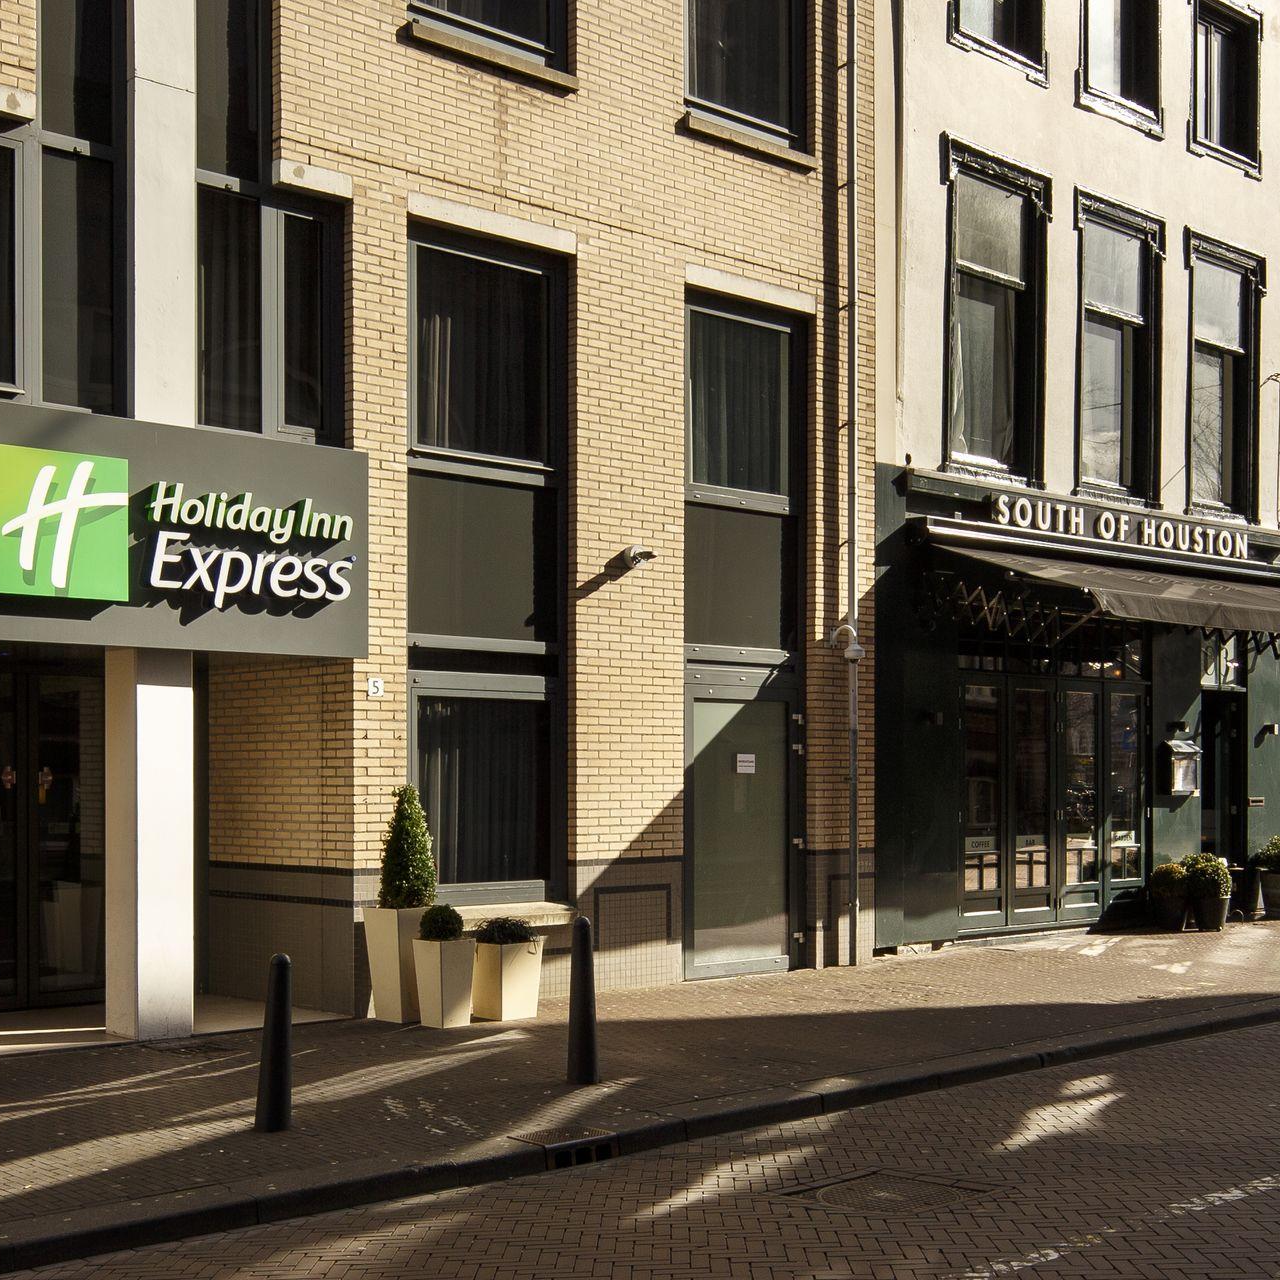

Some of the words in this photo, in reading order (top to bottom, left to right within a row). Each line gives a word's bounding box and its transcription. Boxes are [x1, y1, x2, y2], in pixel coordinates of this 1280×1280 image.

[151, 480, 295, 544] Holiday
[299, 497, 354, 542] Inn
[996, 494, 1084, 535] SOUTH
[1098, 511, 1129, 542] OF
[1142, 517, 1248, 560] HOUSTON
[150, 531, 353, 609] Express
[372, 680, 380, 695] 5
[971, 840, 991, 849] COFFEE
